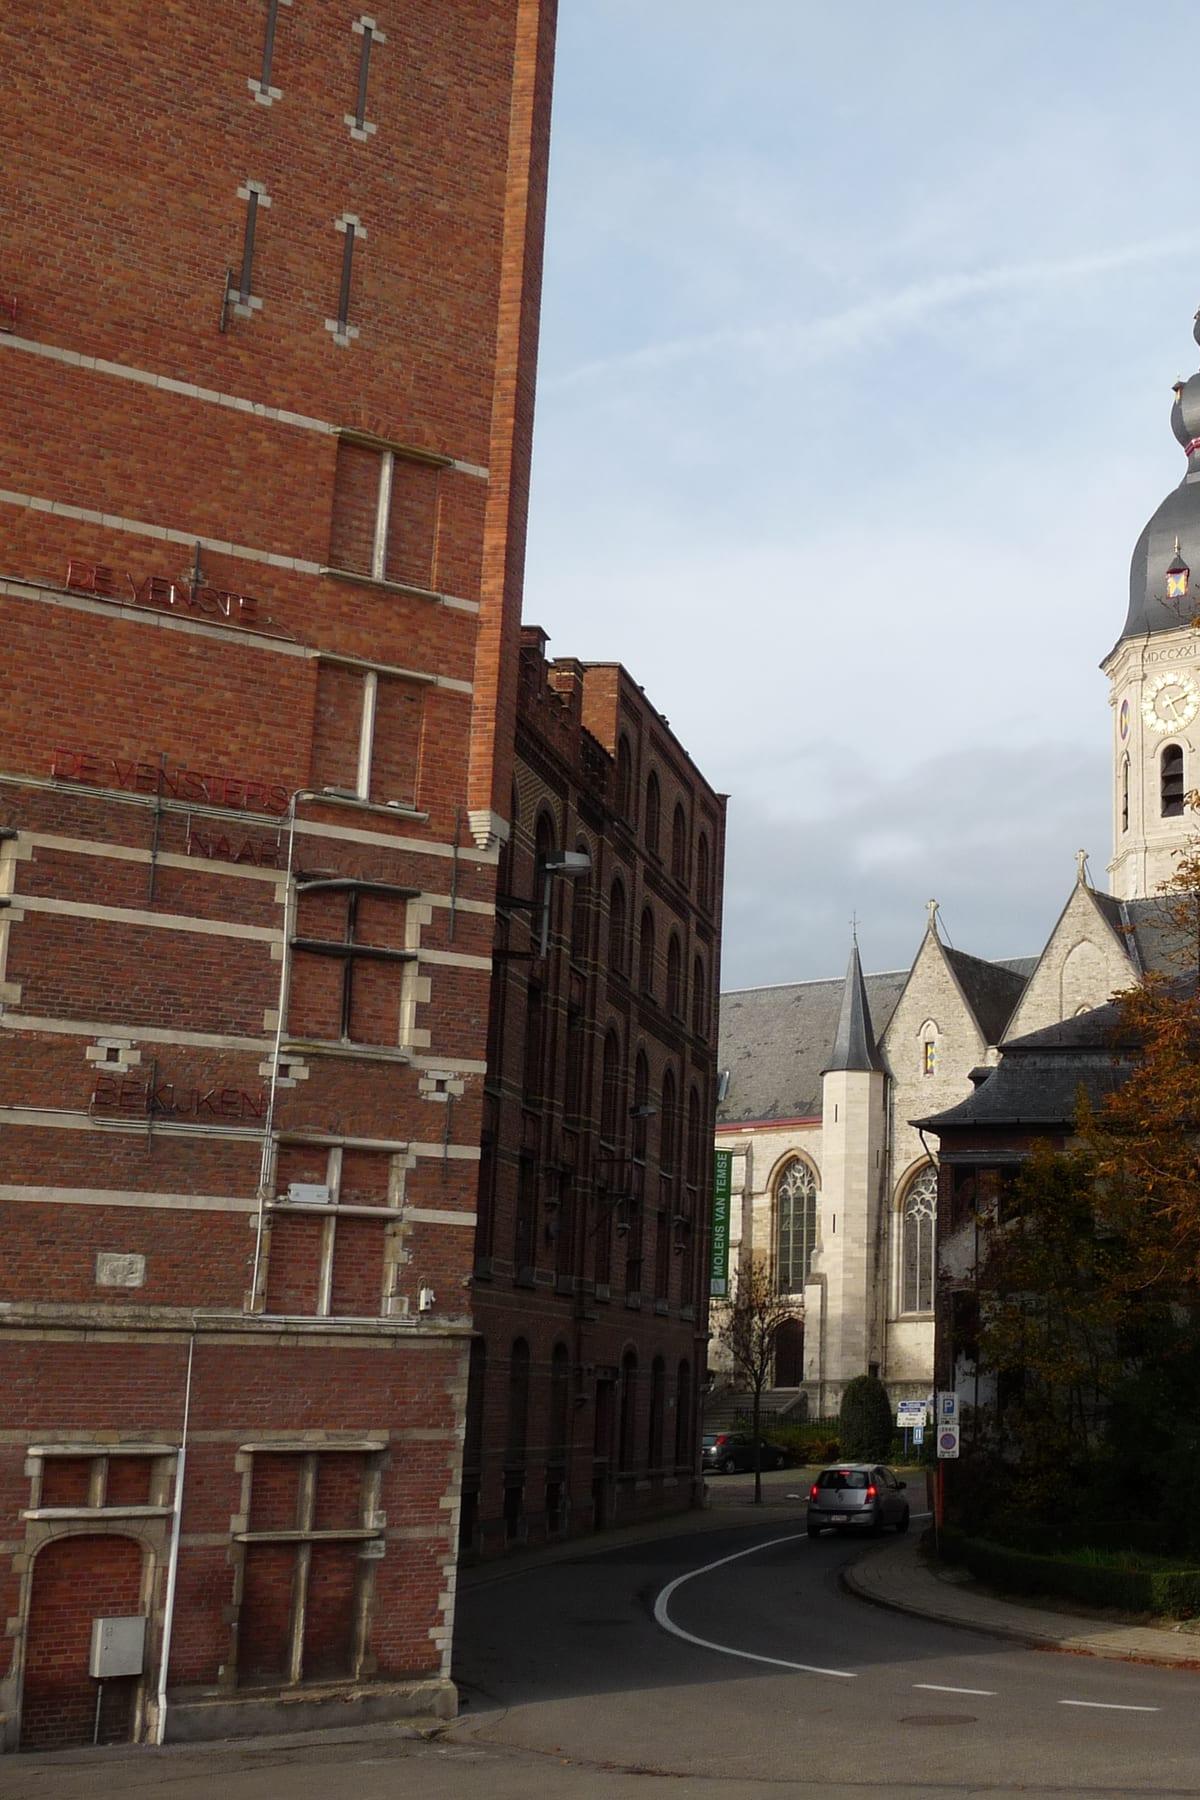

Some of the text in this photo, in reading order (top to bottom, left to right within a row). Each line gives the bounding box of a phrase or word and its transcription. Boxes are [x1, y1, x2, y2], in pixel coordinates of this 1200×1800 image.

[66, 559, 112, 597] DE
[1143, 644, 1197, 663] MDCCXXI
[51, 747, 99, 780] DE
[713, 1153, 728, 1276] MOLENS VAN TEMSE
